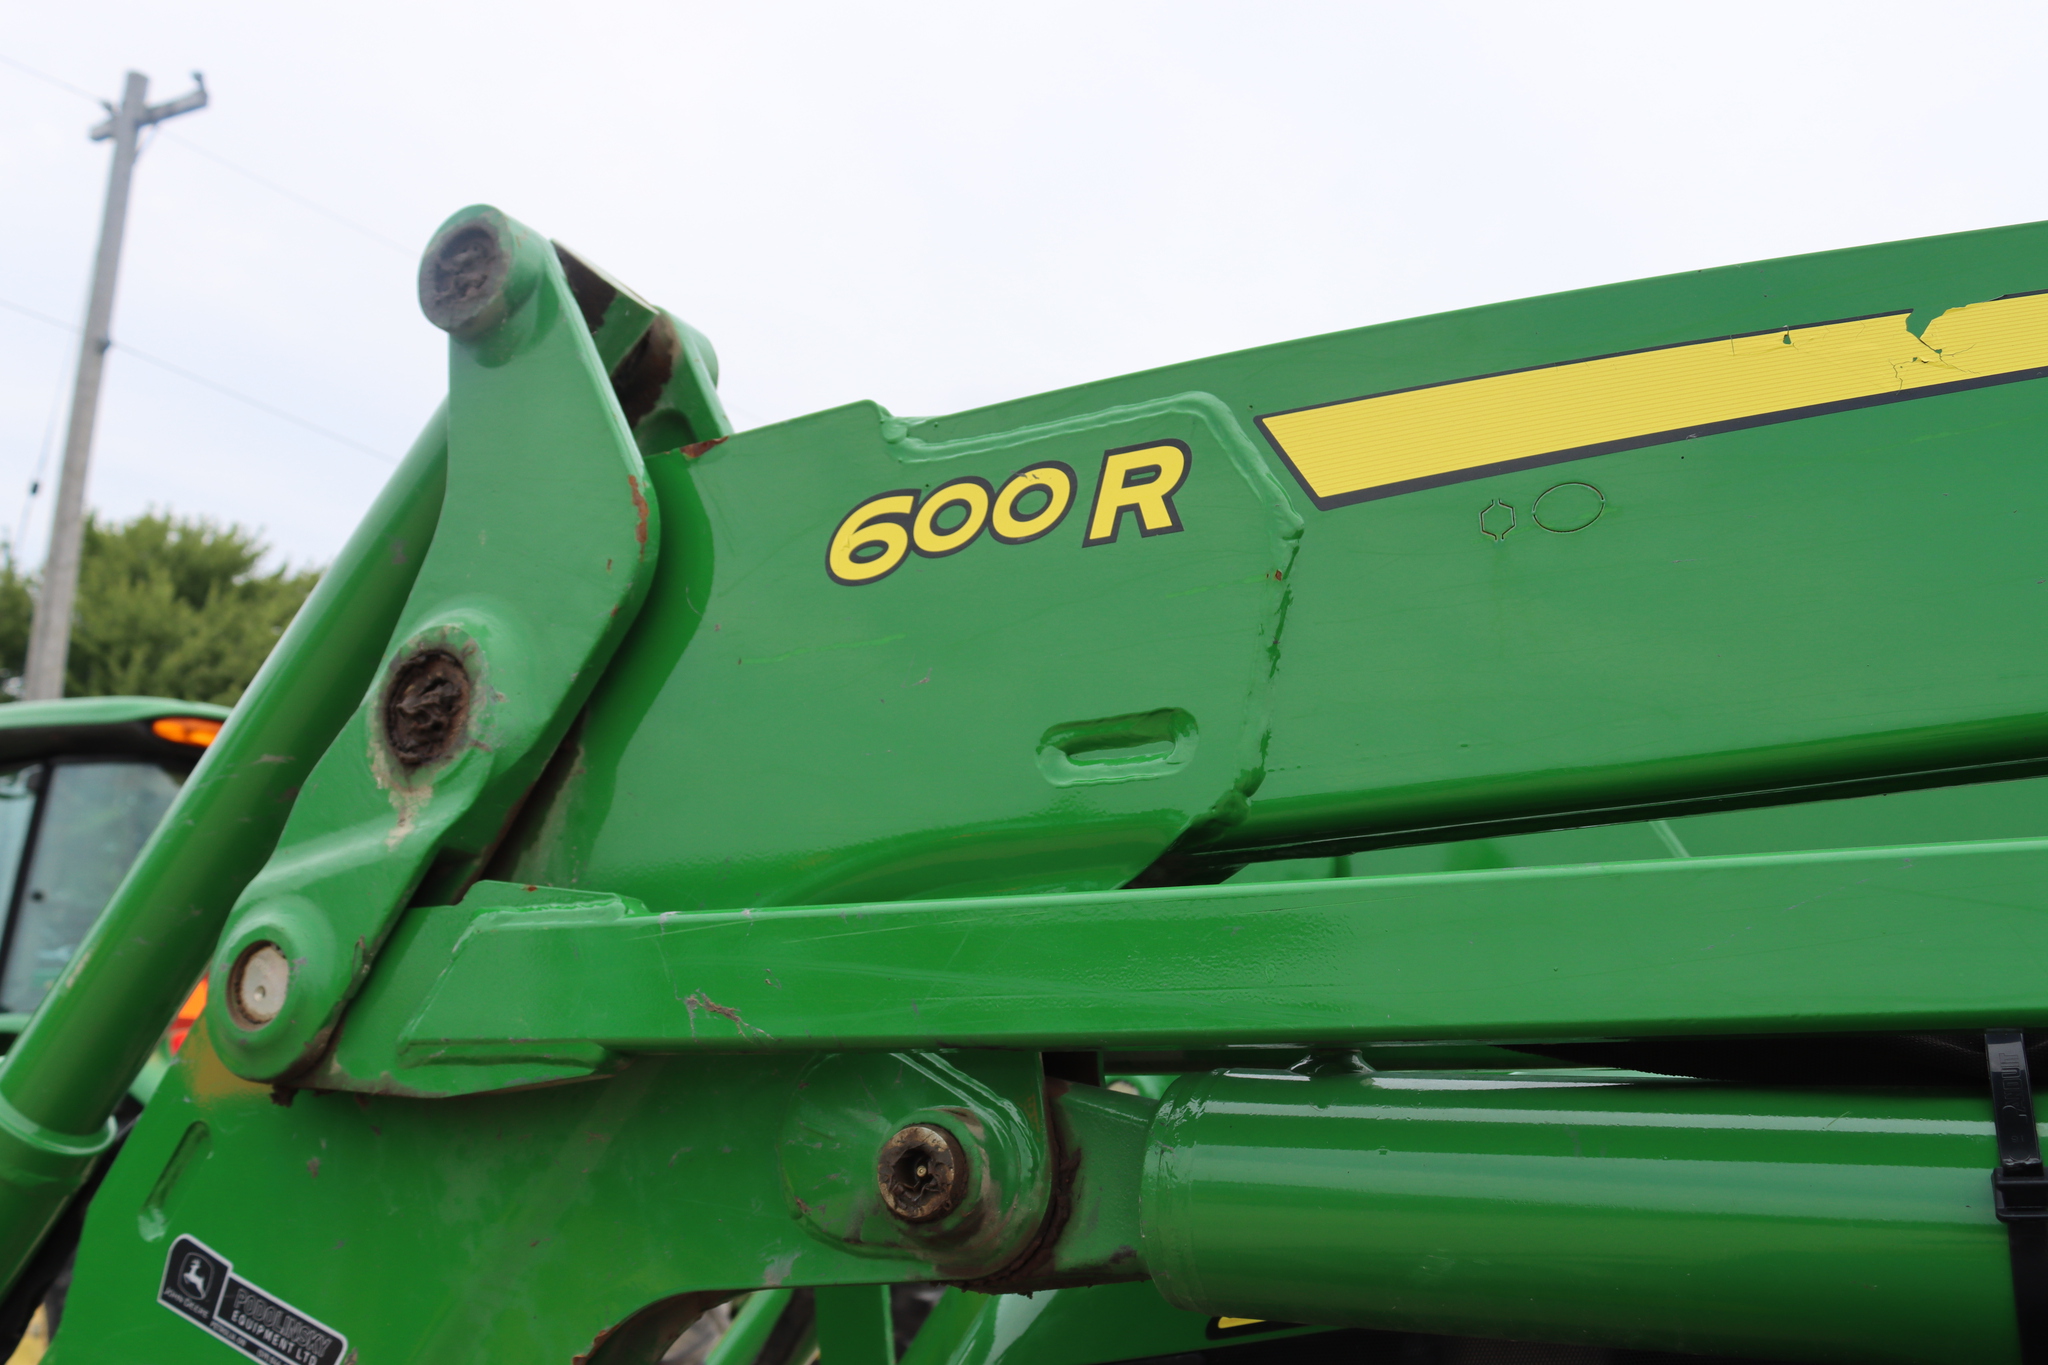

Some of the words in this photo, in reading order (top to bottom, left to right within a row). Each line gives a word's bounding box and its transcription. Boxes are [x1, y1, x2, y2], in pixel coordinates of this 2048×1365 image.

[825, 460, 1078, 587] 600
[1082, 438, 1193, 548] R
[231, 1309, 296, 1355] EQUIPMENT
[233, 1288, 333, 1358] PODOLINSKY
